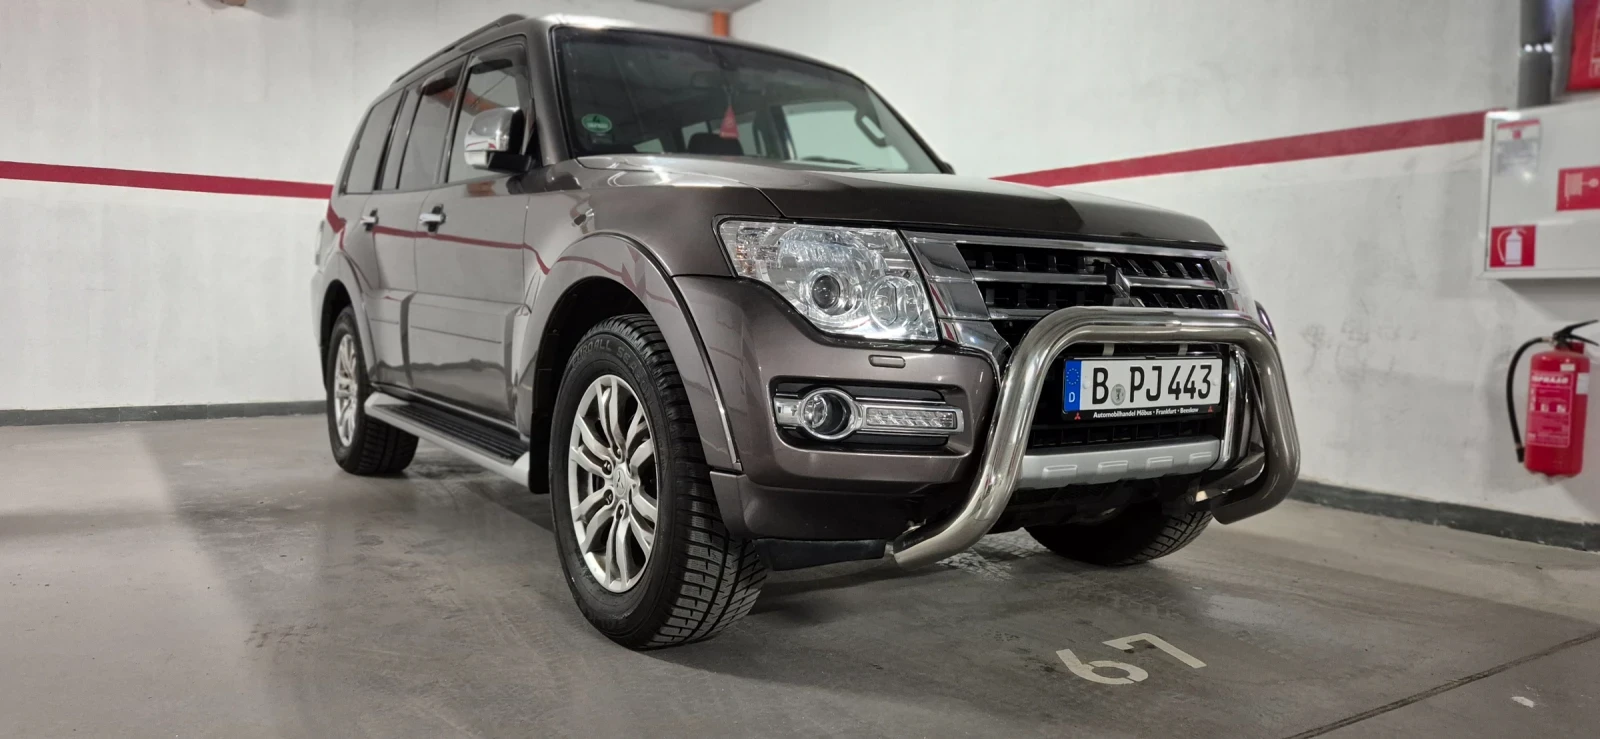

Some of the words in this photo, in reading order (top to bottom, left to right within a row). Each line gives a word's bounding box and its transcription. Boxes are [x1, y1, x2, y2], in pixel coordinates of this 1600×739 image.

[1068, 391, 1076, 403] D
[1092, 367, 1109, 405] B
[1129, 366, 1163, 403] PJ
[1167, 364, 1212, 401] 443
[1093, 410, 1135, 418] Automobilhandel
[1136, 409, 1153, 417] Möbus
[1056, 632, 1207, 685] 67
